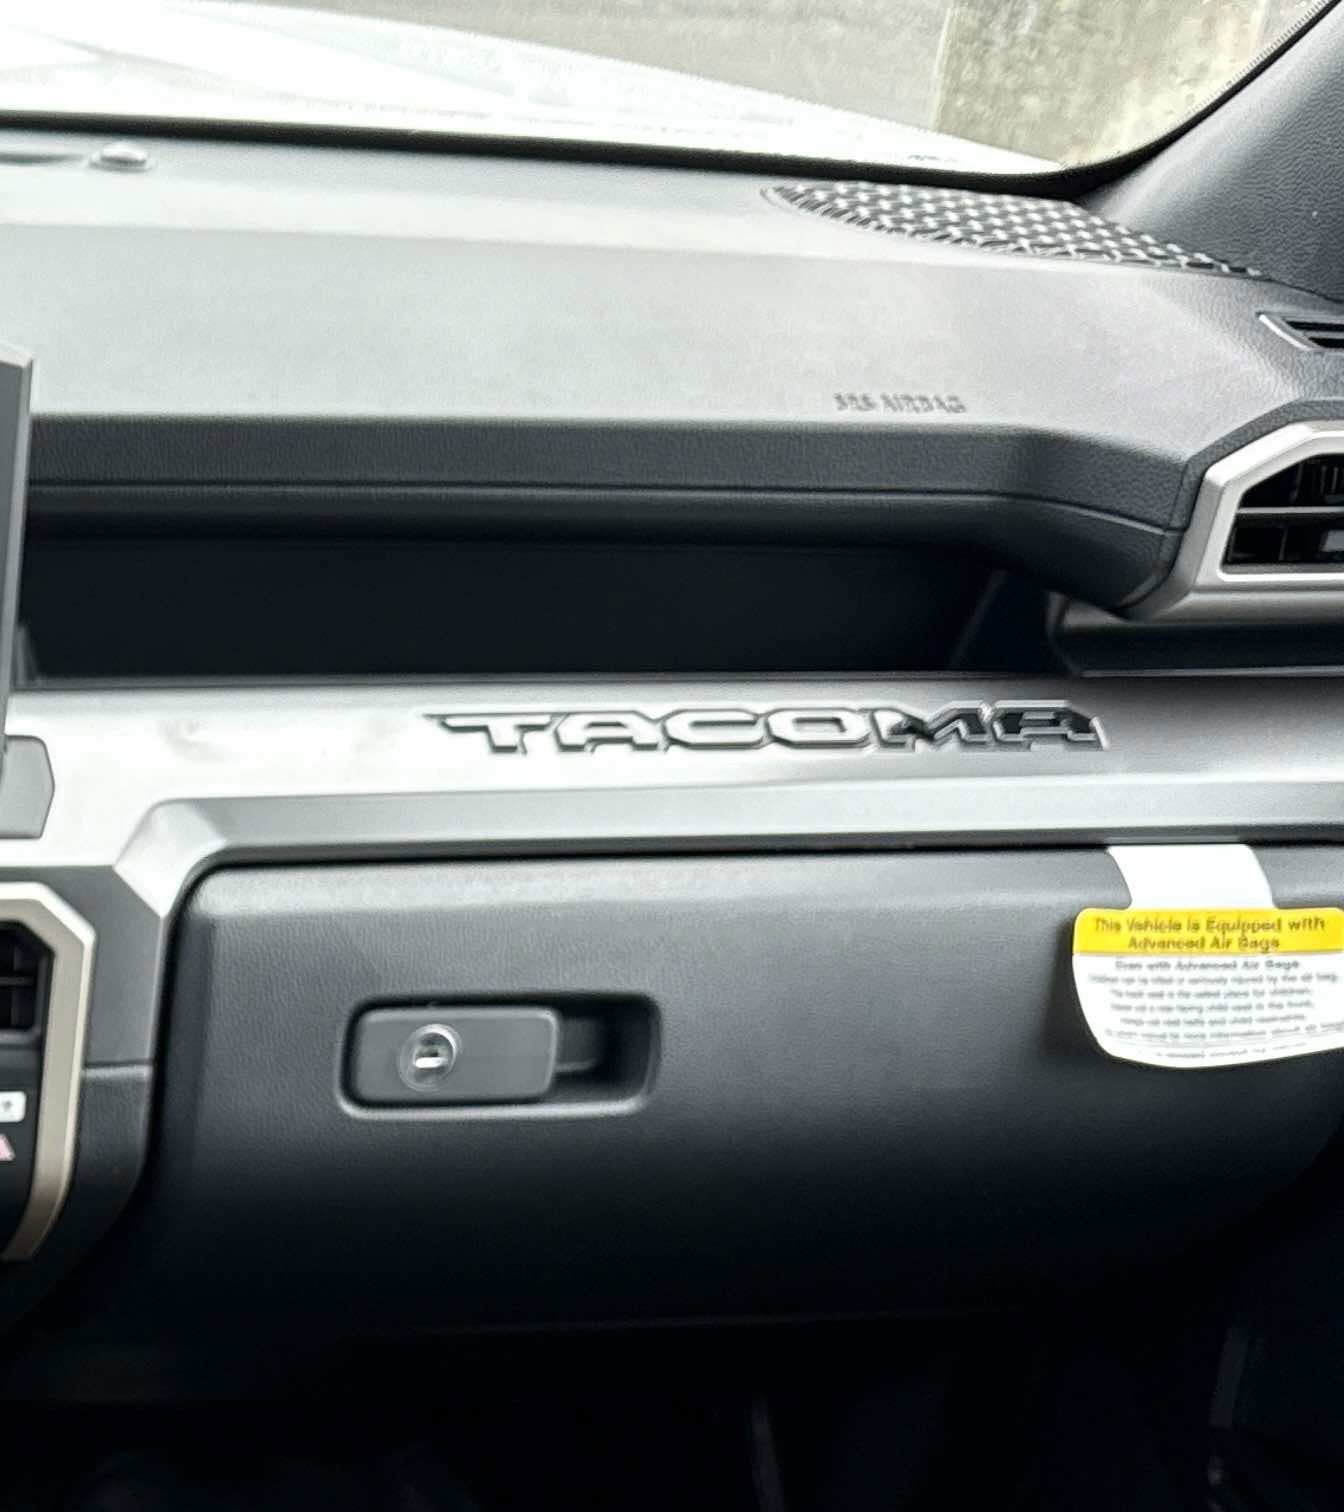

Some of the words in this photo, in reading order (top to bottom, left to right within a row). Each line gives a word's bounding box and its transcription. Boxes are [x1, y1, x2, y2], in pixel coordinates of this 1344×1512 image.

[425, 705, 1110, 754] TACOMA
[1096, 917, 1121, 932] This
[1127, 917, 1182, 932] Vehicle
[1186, 917, 1200, 932] is
[1205, 917, 1282, 937] Equipped
[1288, 916, 1325, 931] with
[1128, 936, 1205, 950] Advanced
[1211, 936, 1233, 950] Air
[1238, 936, 1280, 954] Bags
